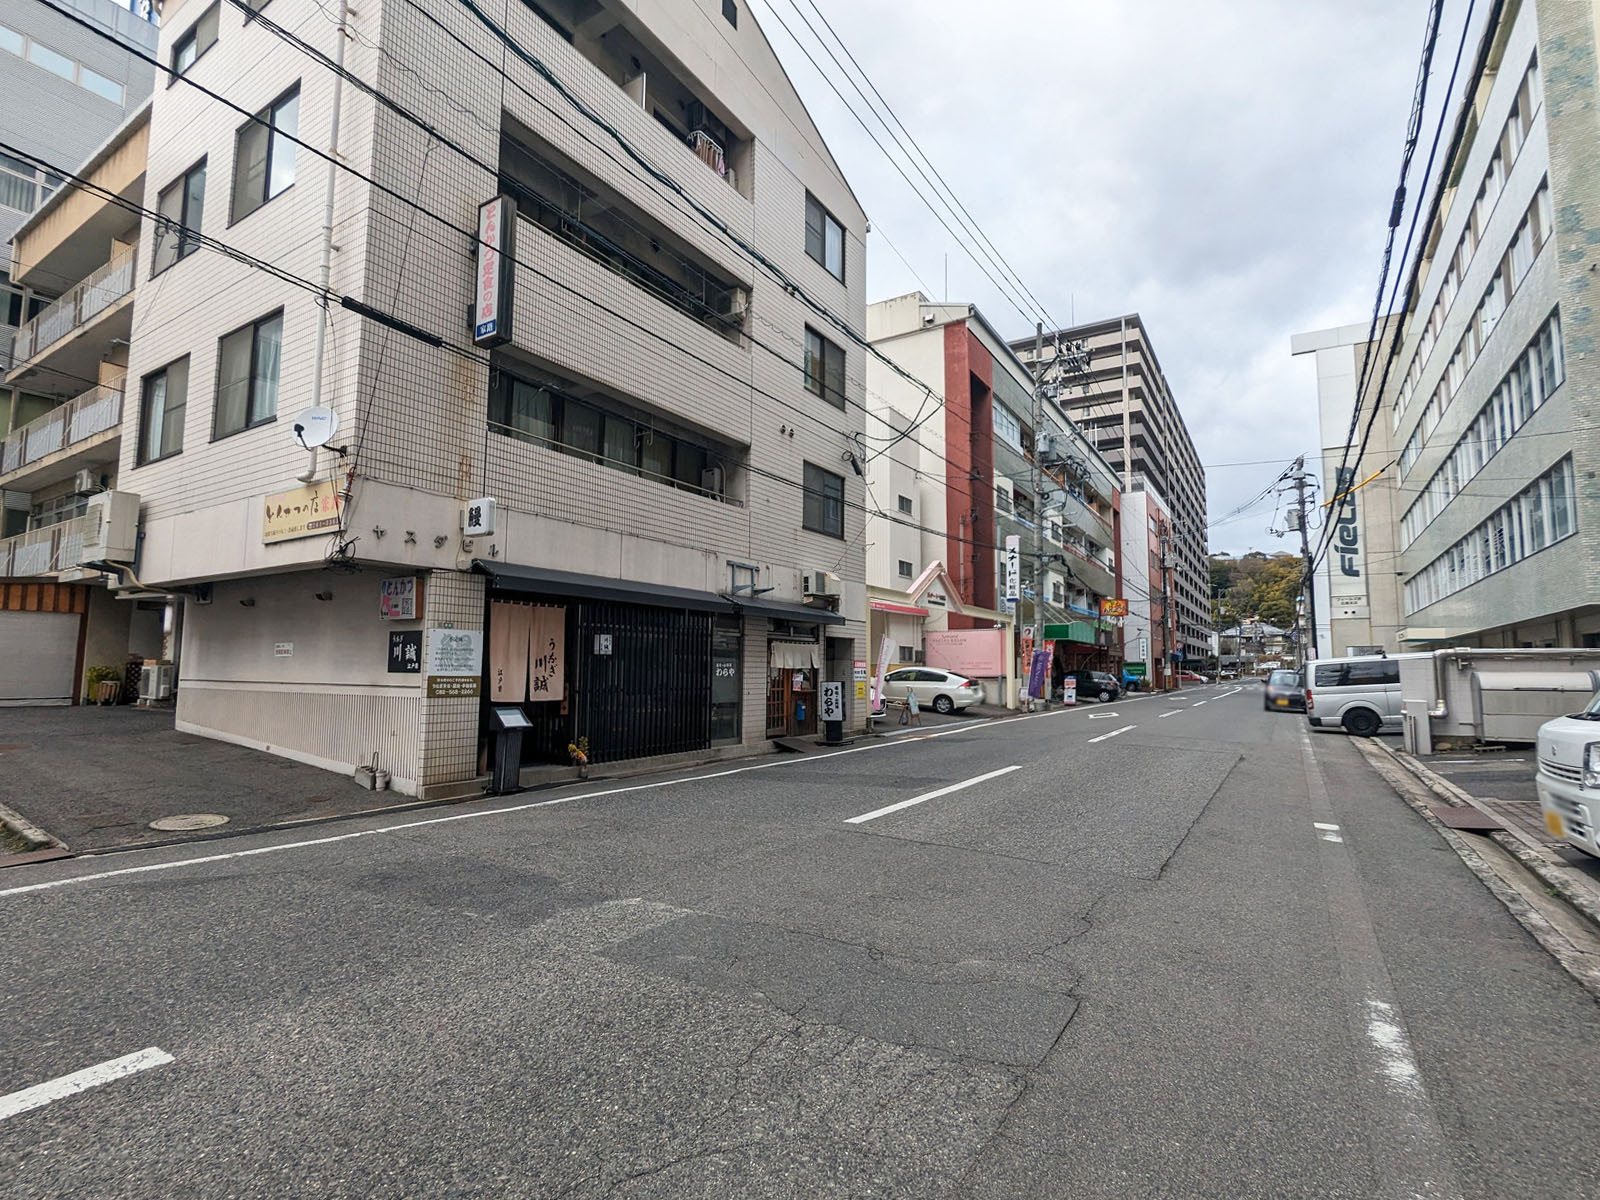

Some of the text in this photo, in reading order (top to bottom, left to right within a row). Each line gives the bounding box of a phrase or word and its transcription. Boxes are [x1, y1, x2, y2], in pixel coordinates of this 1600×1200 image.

[468, 505, 482, 527] 鰻
[372, 524, 499, 558] ヤスダビル
[1008, 547, 1017, 597] メナード化粧品
[533, 654, 548, 692] 川誠
[716, 667, 735, 677] わらや
[824, 687, 834, 717] わらや
